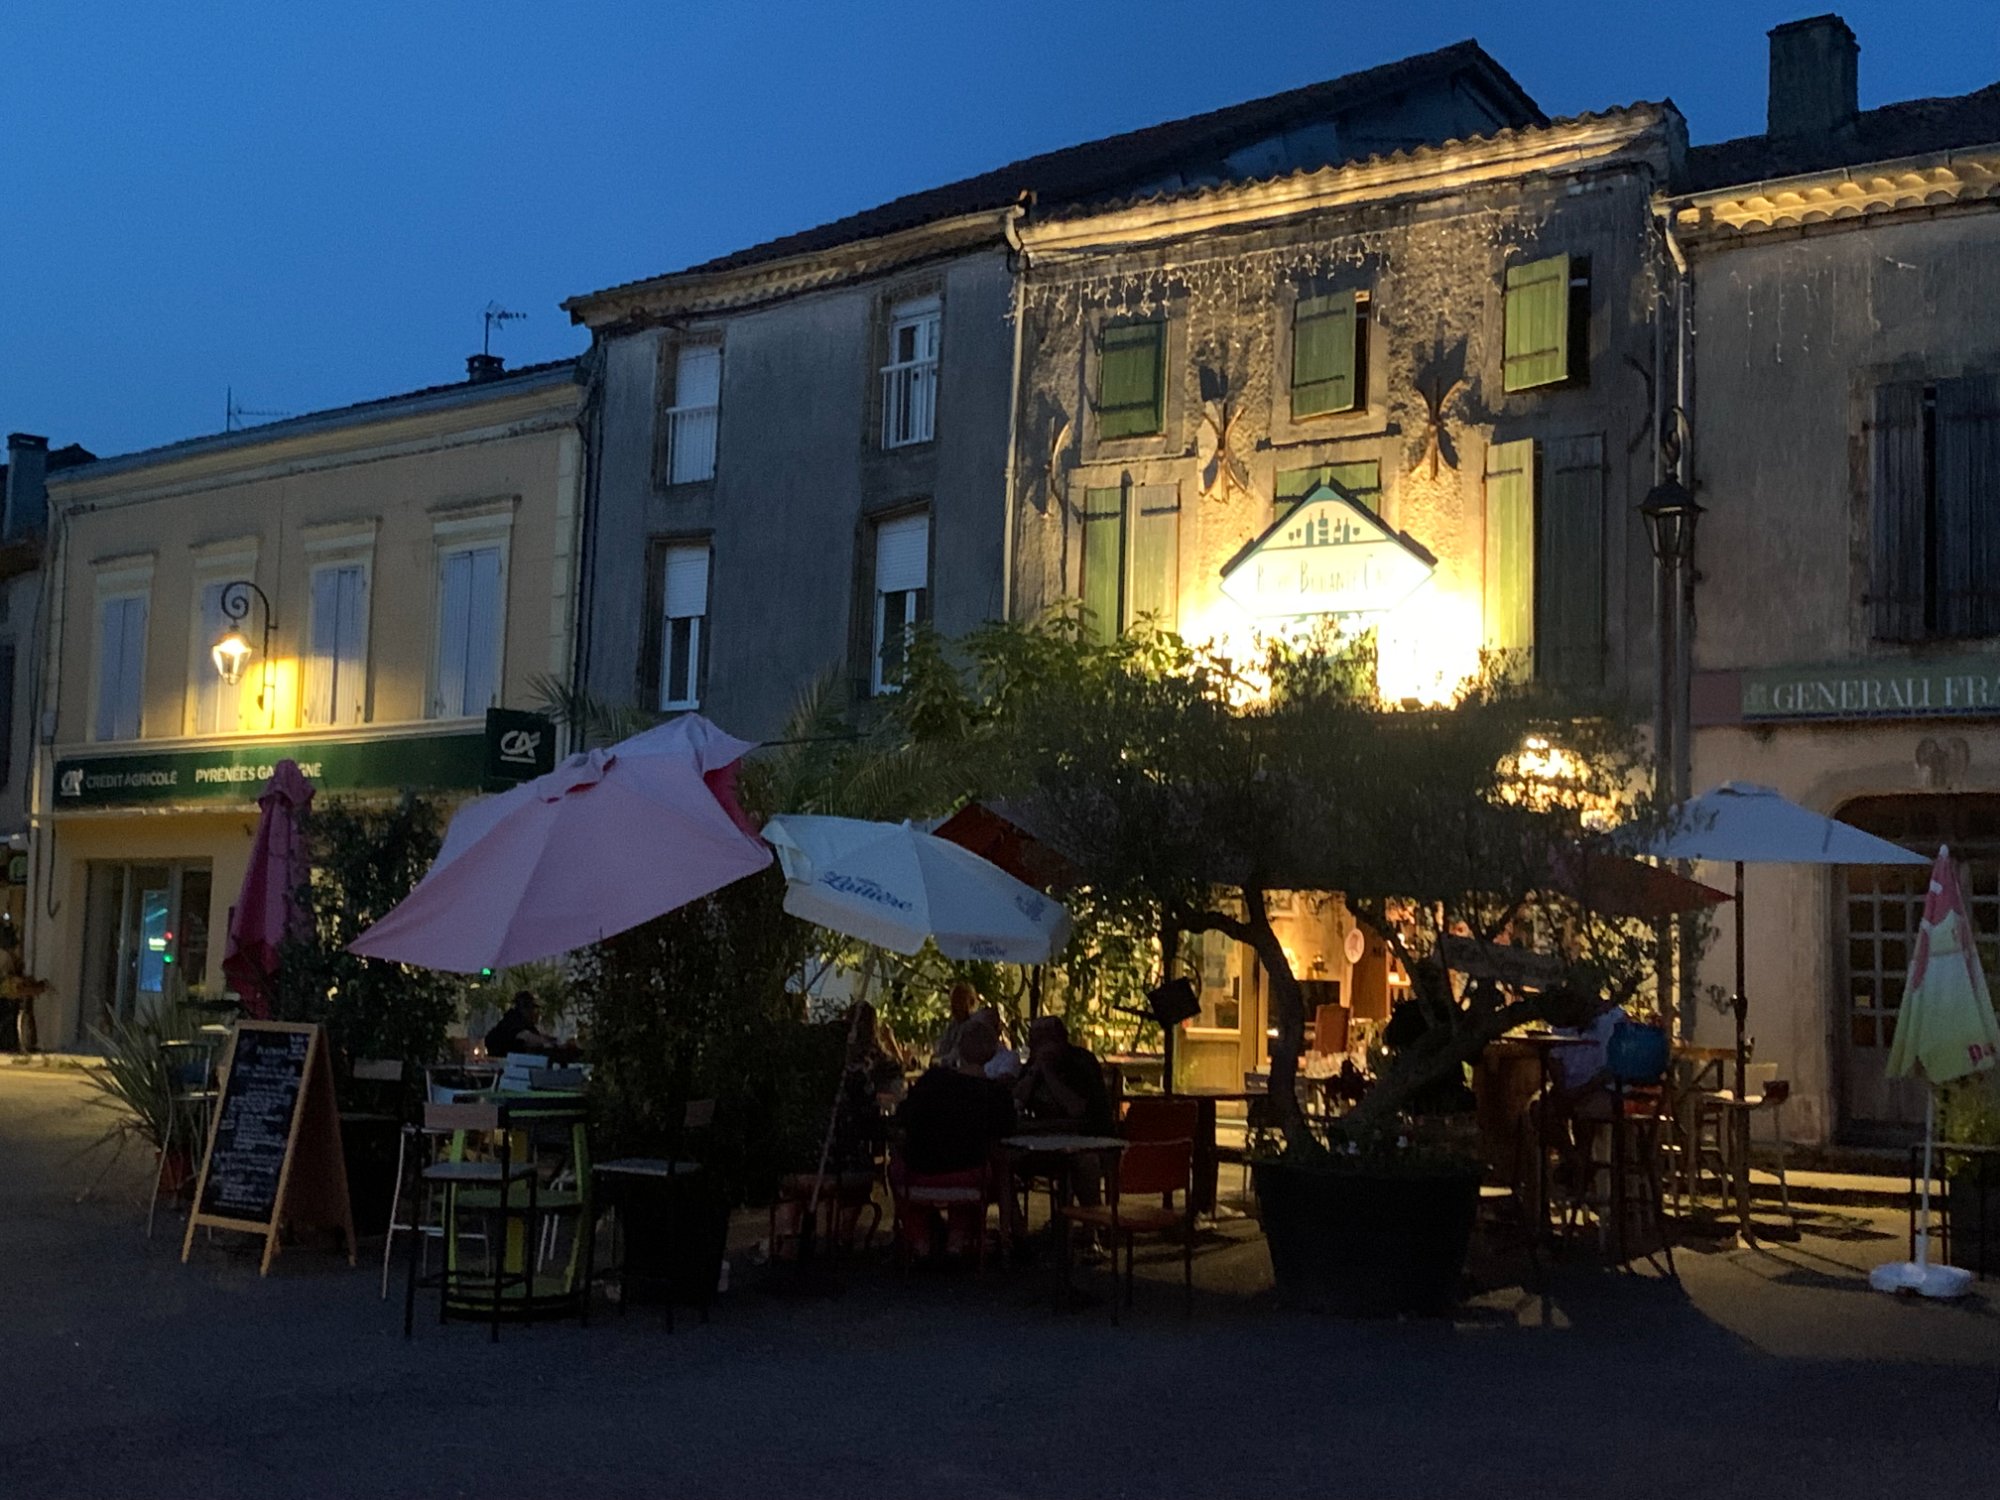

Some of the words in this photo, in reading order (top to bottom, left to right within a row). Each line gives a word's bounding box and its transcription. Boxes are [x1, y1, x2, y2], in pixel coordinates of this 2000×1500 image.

[1773, 678, 1930, 710] GENERALI
[124, 769, 177, 787] AGRICOLE
[257, 762, 322, 780] GAGNE
